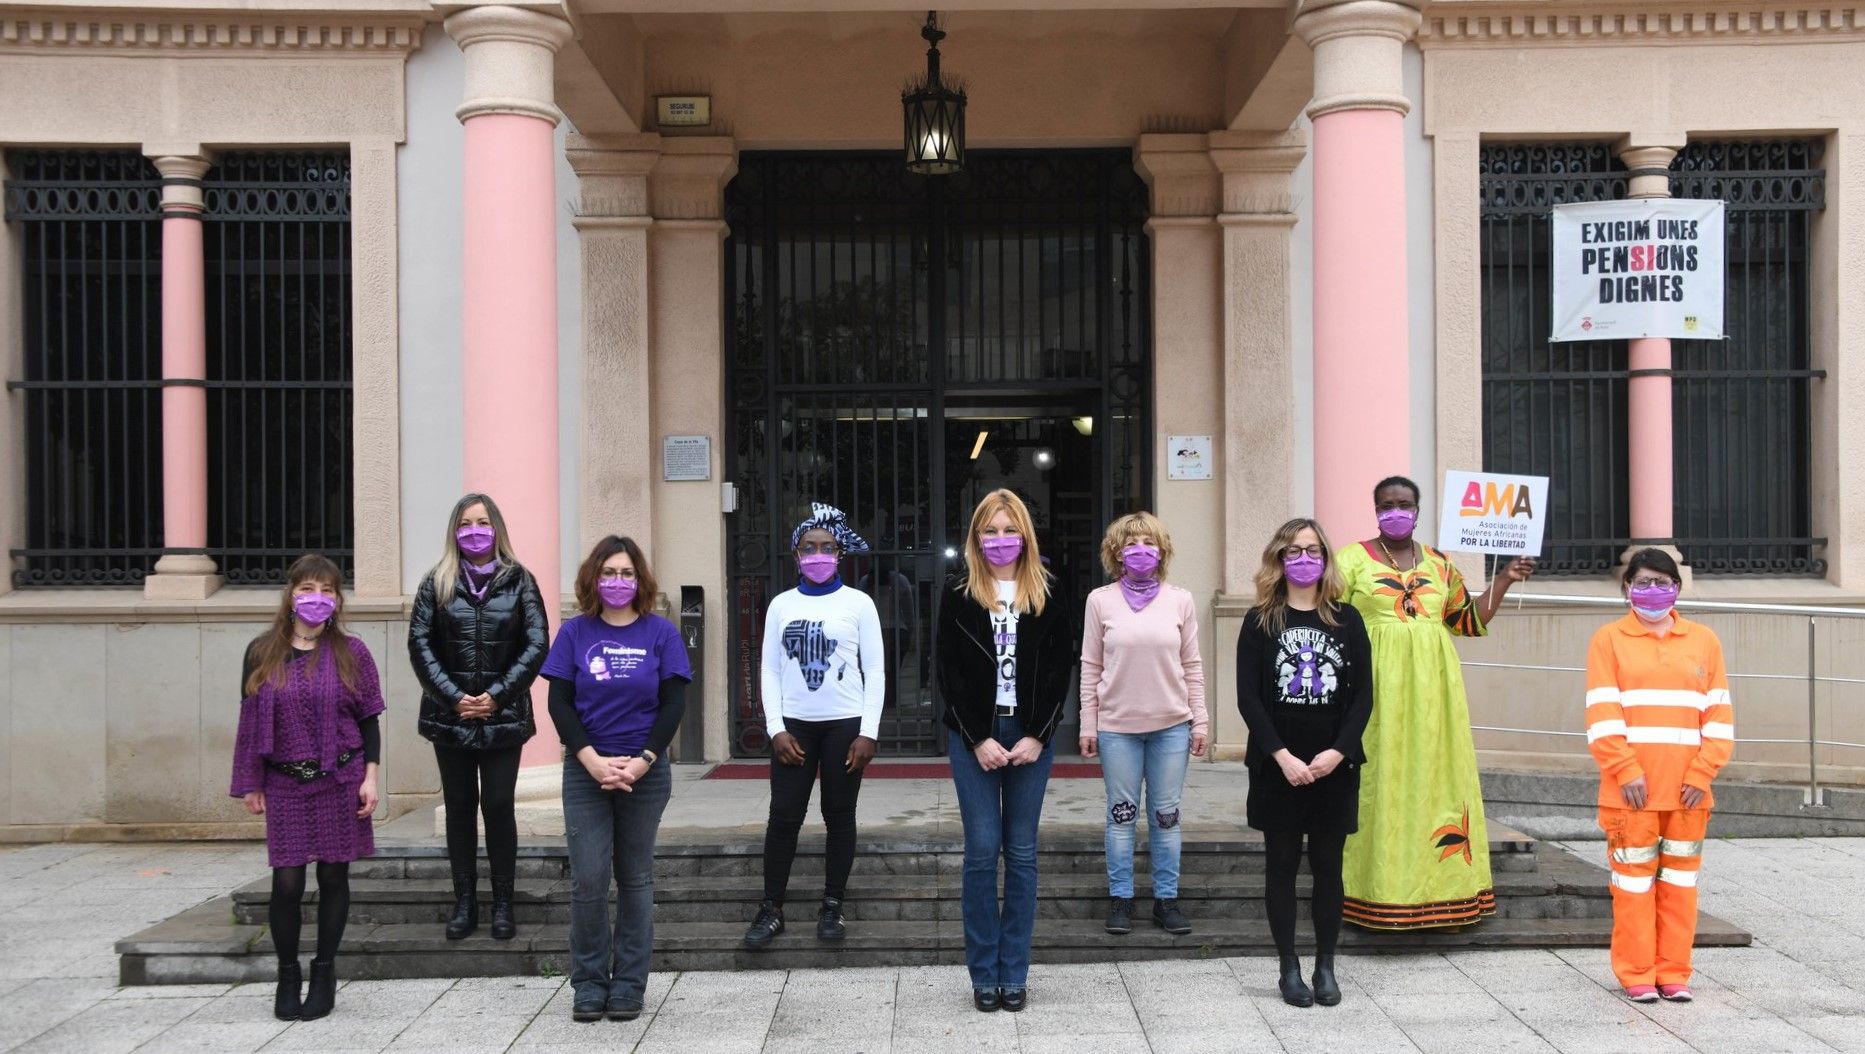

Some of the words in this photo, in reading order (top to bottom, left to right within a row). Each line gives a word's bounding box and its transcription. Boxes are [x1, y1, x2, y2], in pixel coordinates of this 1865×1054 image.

[1582, 220, 1650, 244] EXIGIM
[1657, 219, 1698, 241] UNES
[1582, 245, 1698, 275] PENSIONS
[1599, 275, 1684, 304] DIGNES
[1460, 481, 1532, 519] AMA
[1461, 528, 1492, 537] Mujeres
[1494, 530, 1526, 539] Africanas
[1479, 521, 1518, 530] Asociación
[1460, 537, 1477, 546] POR
[1479, 538, 1489, 547] LA
[1492, 539, 1526, 549] LIBERTAD
